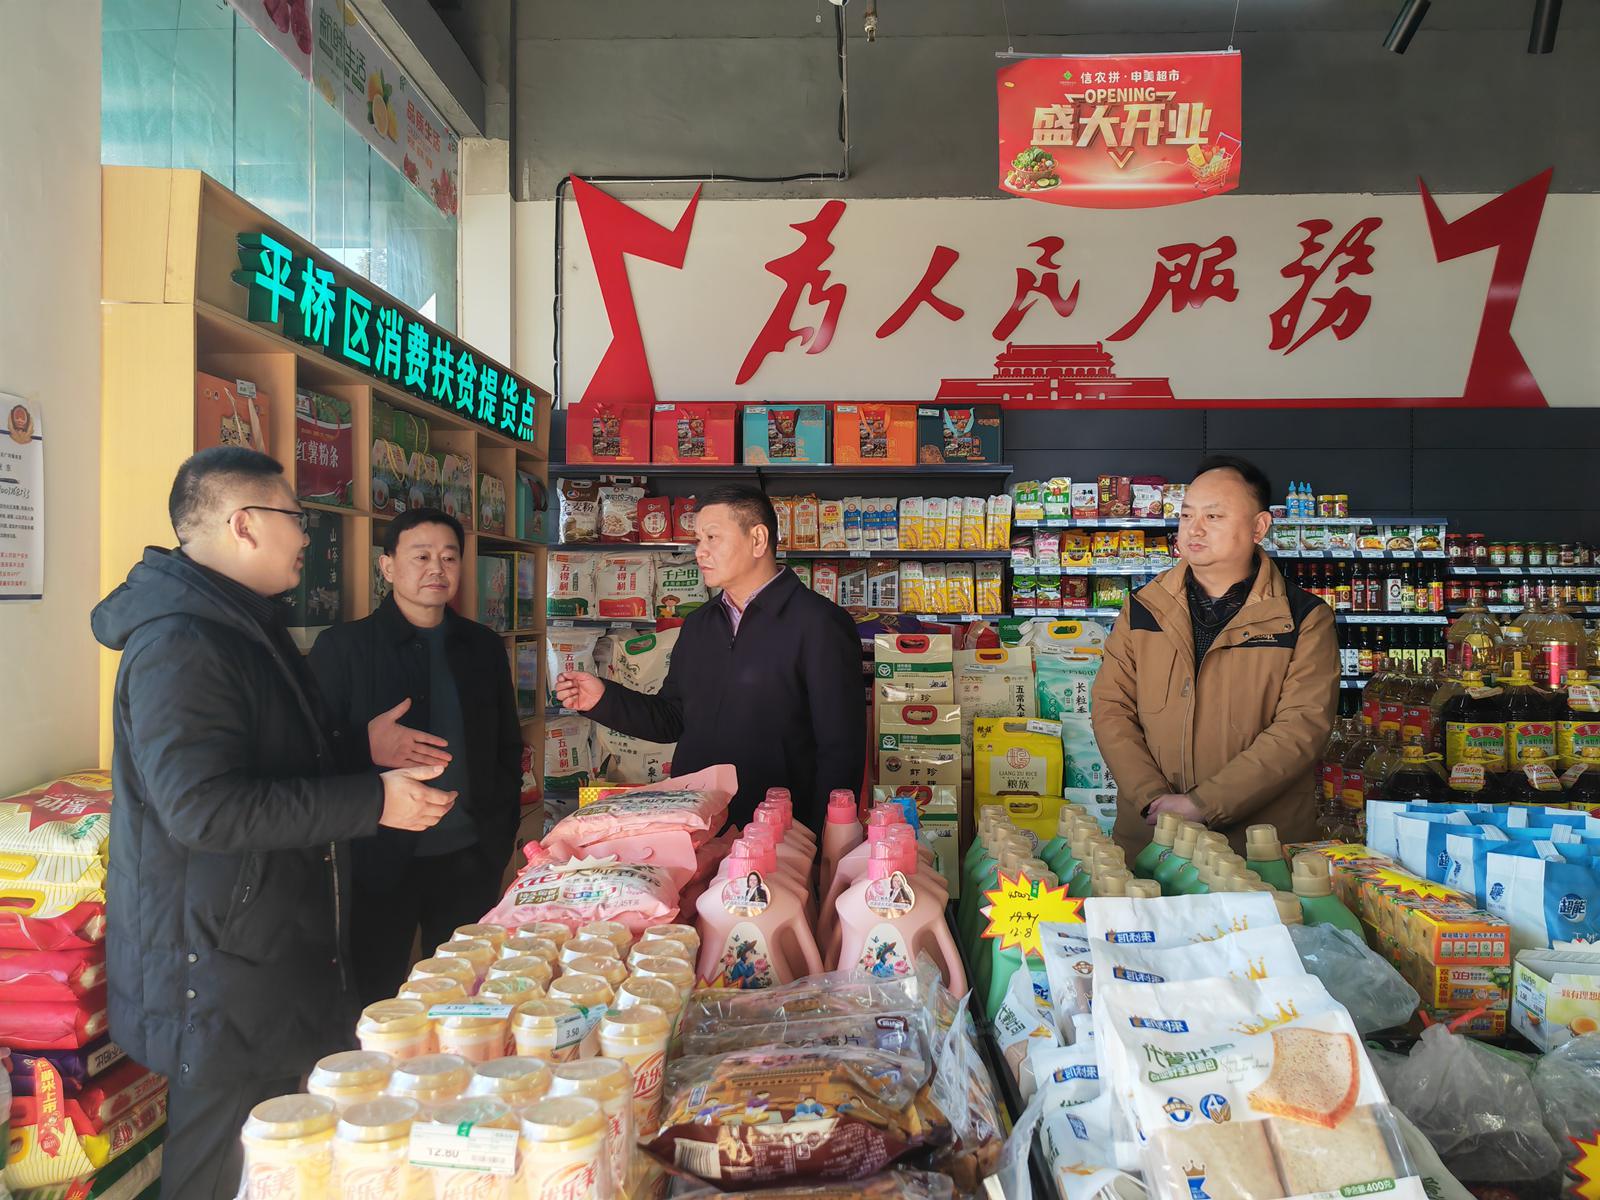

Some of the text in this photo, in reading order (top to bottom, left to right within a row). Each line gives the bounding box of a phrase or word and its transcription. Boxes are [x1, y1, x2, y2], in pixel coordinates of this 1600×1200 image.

[1080, 69, 1180, 84] 信农拼·申美超市
[1084, 86, 1156, 104] OPENING
[1030, 102, 1213, 148] 盛大开业
[255, 232, 536, 443] 平桥区消费扶贫提货点
[559, 563, 570, 592] 五得利
[616, 566, 627, 591] 五得利
[663, 568, 699, 580] 千户田
[1007, 779, 1030, 789] 粮族
[1558, 897, 1586, 915] 超能
[1010, 927, 1033, 938] 12.8
[1452, 971, 1470, 980] 立白
[566, 1027, 580, 1039] 3.50
